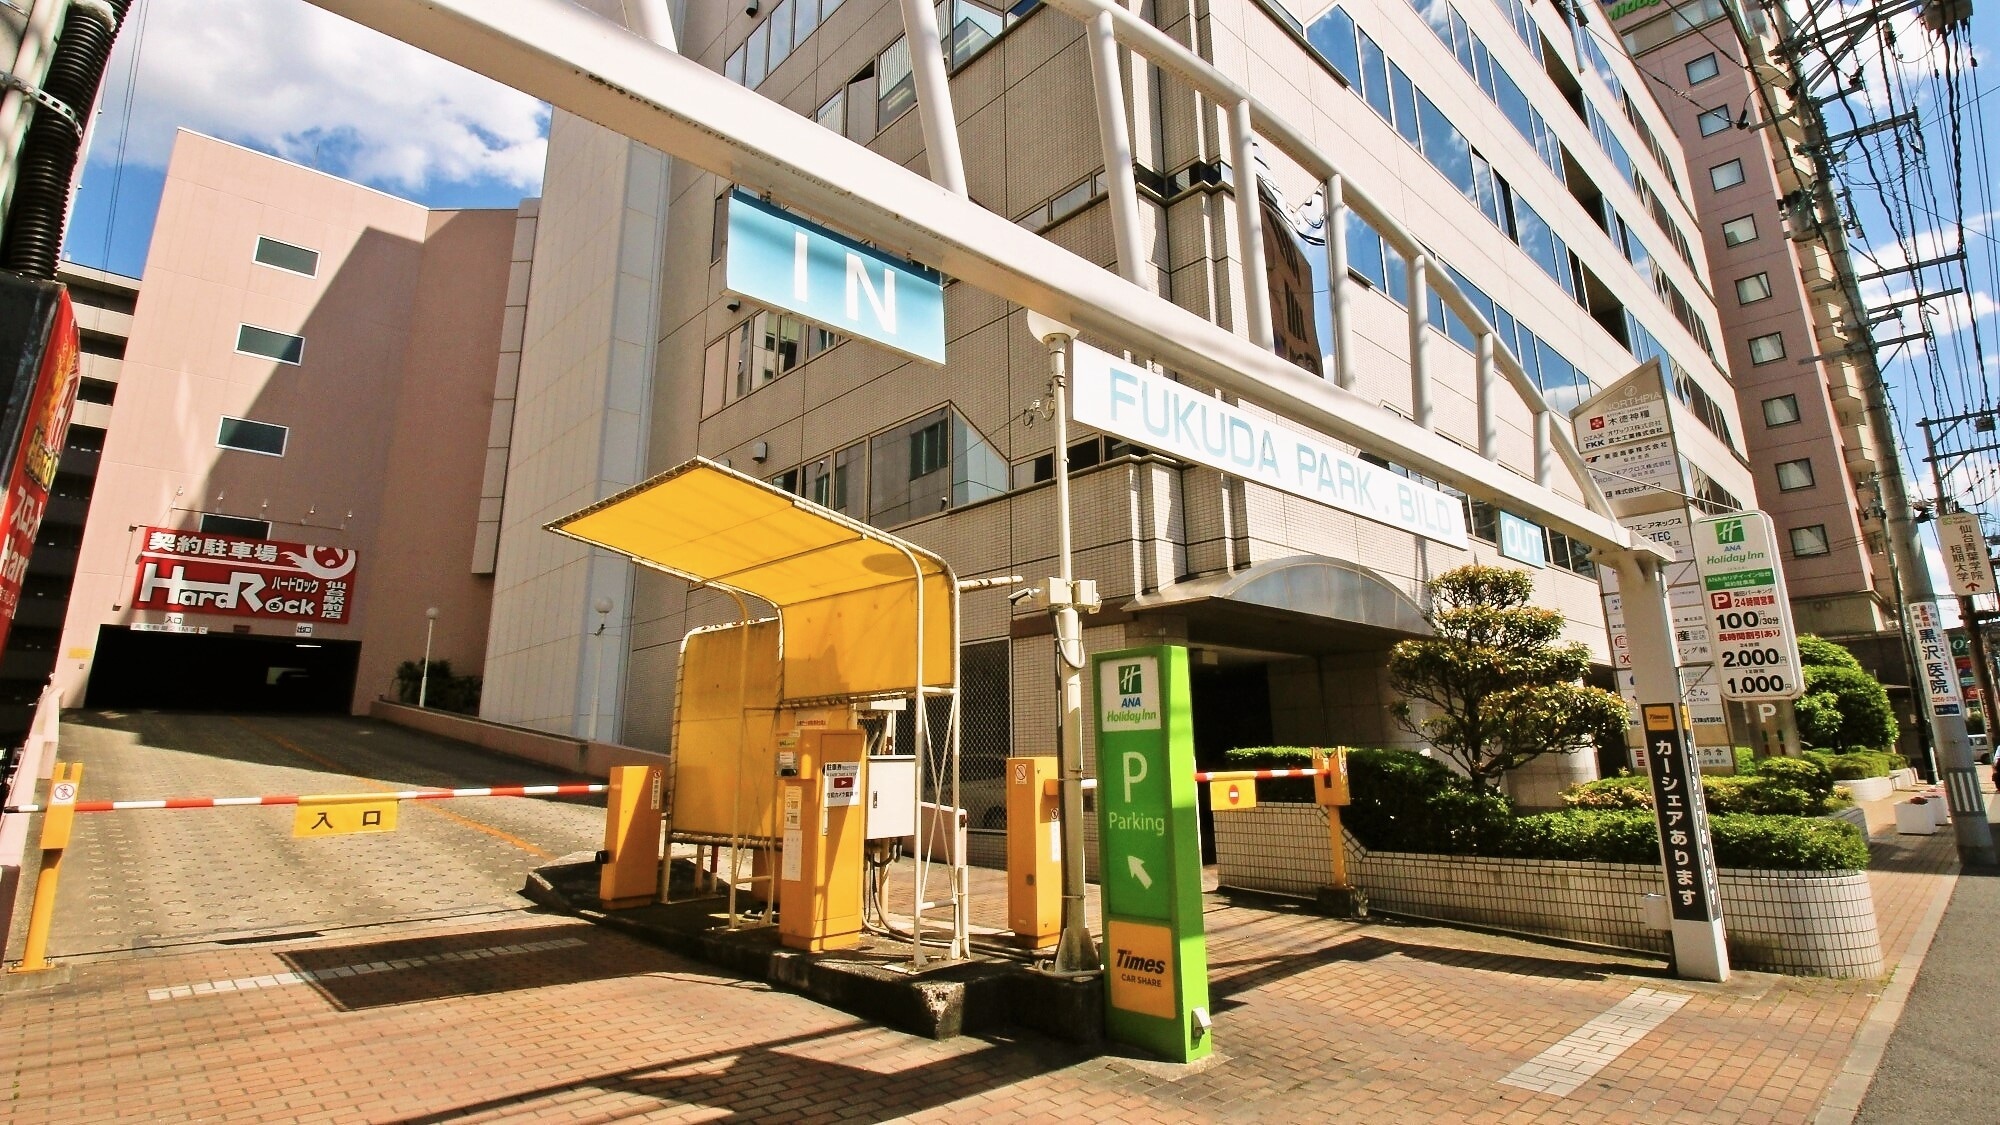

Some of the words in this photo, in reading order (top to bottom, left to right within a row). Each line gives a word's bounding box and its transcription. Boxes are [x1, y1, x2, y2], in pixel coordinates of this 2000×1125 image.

[794, 231, 896, 334] IN
[1110, 367, 1279, 477] FUKUDA
[1399, 482, 1452, 536] BILD
[1585, 440, 1605, 449] FKK
[1505, 518, 1541, 561] OUT
[1642, 530, 1671, 543] -TEC
[149, 531, 278, 562] 契約駐車場
[1707, 553, 1746, 564] Holiday
[1747, 551, 1764, 560] Inn
[271, 576, 319, 594] ハードロック
[1716, 611, 1759, 629] 100
[1718, 630, 1780, 641] 長時間割引あり
[1722, 648, 1779, 668] 2,000
[1919, 629, 1948, 694] 黒沢医院
[1727, 675, 1784, 693] 1,000
[1121, 697, 1141, 708] ANA
[1106, 710, 1141, 724] Holiday
[1142, 708, 1156, 720] Inn
[1122, 751, 1148, 803] P
[311, 810, 381, 829] 入口
[1109, 812, 1165, 836] Parking
[1655, 740, 1697, 906] カーシェアあります
[1117, 948, 1165, 974] Times
[1121, 973, 1136, 983] CAR
[1137, 976, 1162, 988] SHARE
